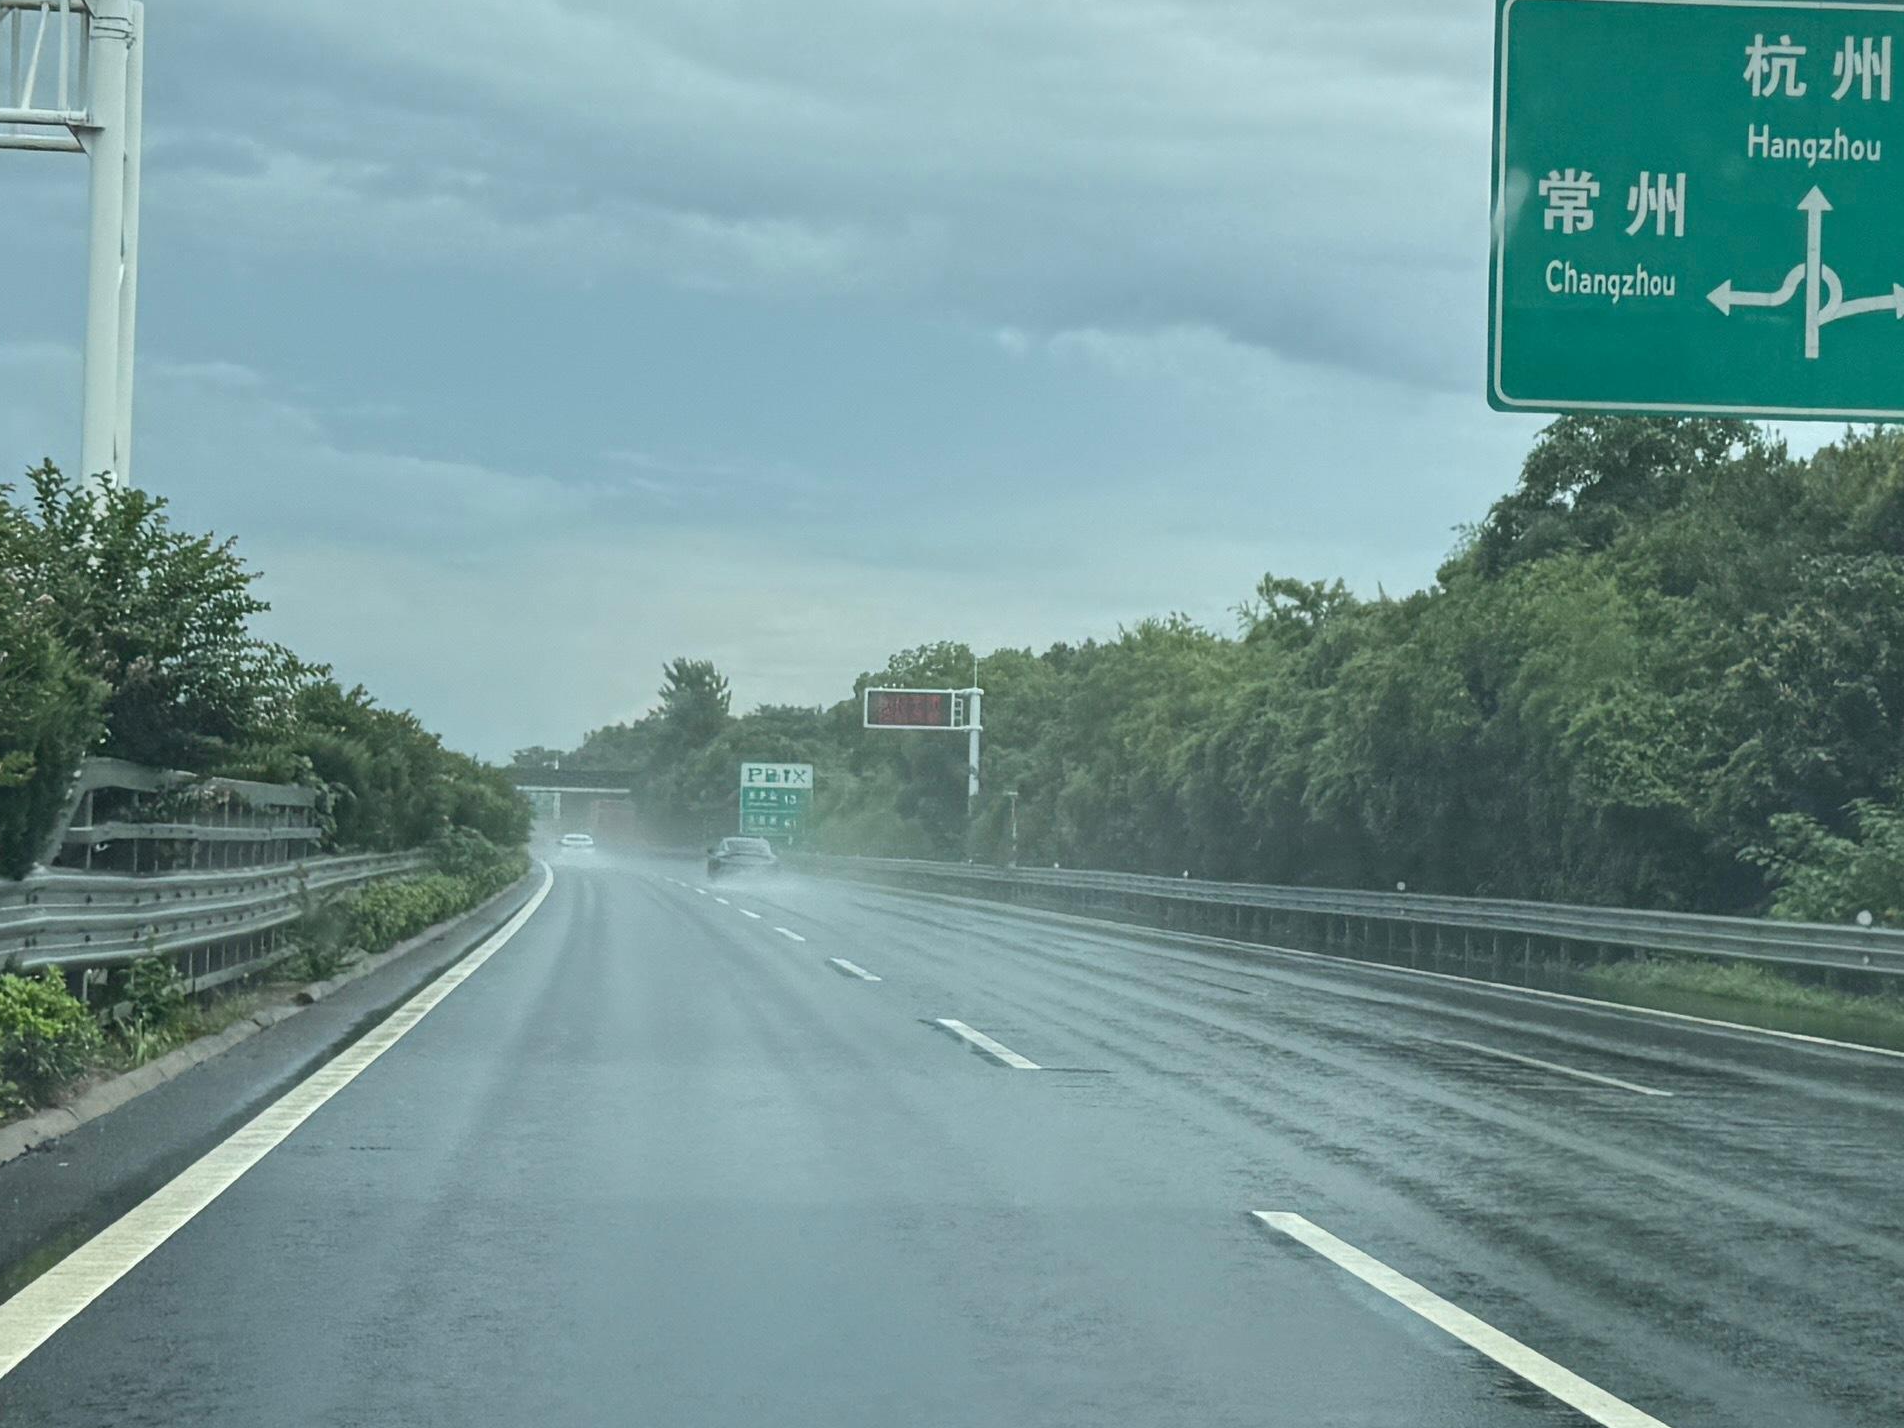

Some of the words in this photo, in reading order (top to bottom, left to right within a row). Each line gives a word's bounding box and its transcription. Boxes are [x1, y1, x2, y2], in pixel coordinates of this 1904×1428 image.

[1743, 34, 1891, 101] 杭州
[1748, 124, 1881, 167] Hangzhou
[1539, 168, 1686, 237] 常州
[1546, 260, 1675, 303] Changzhou
